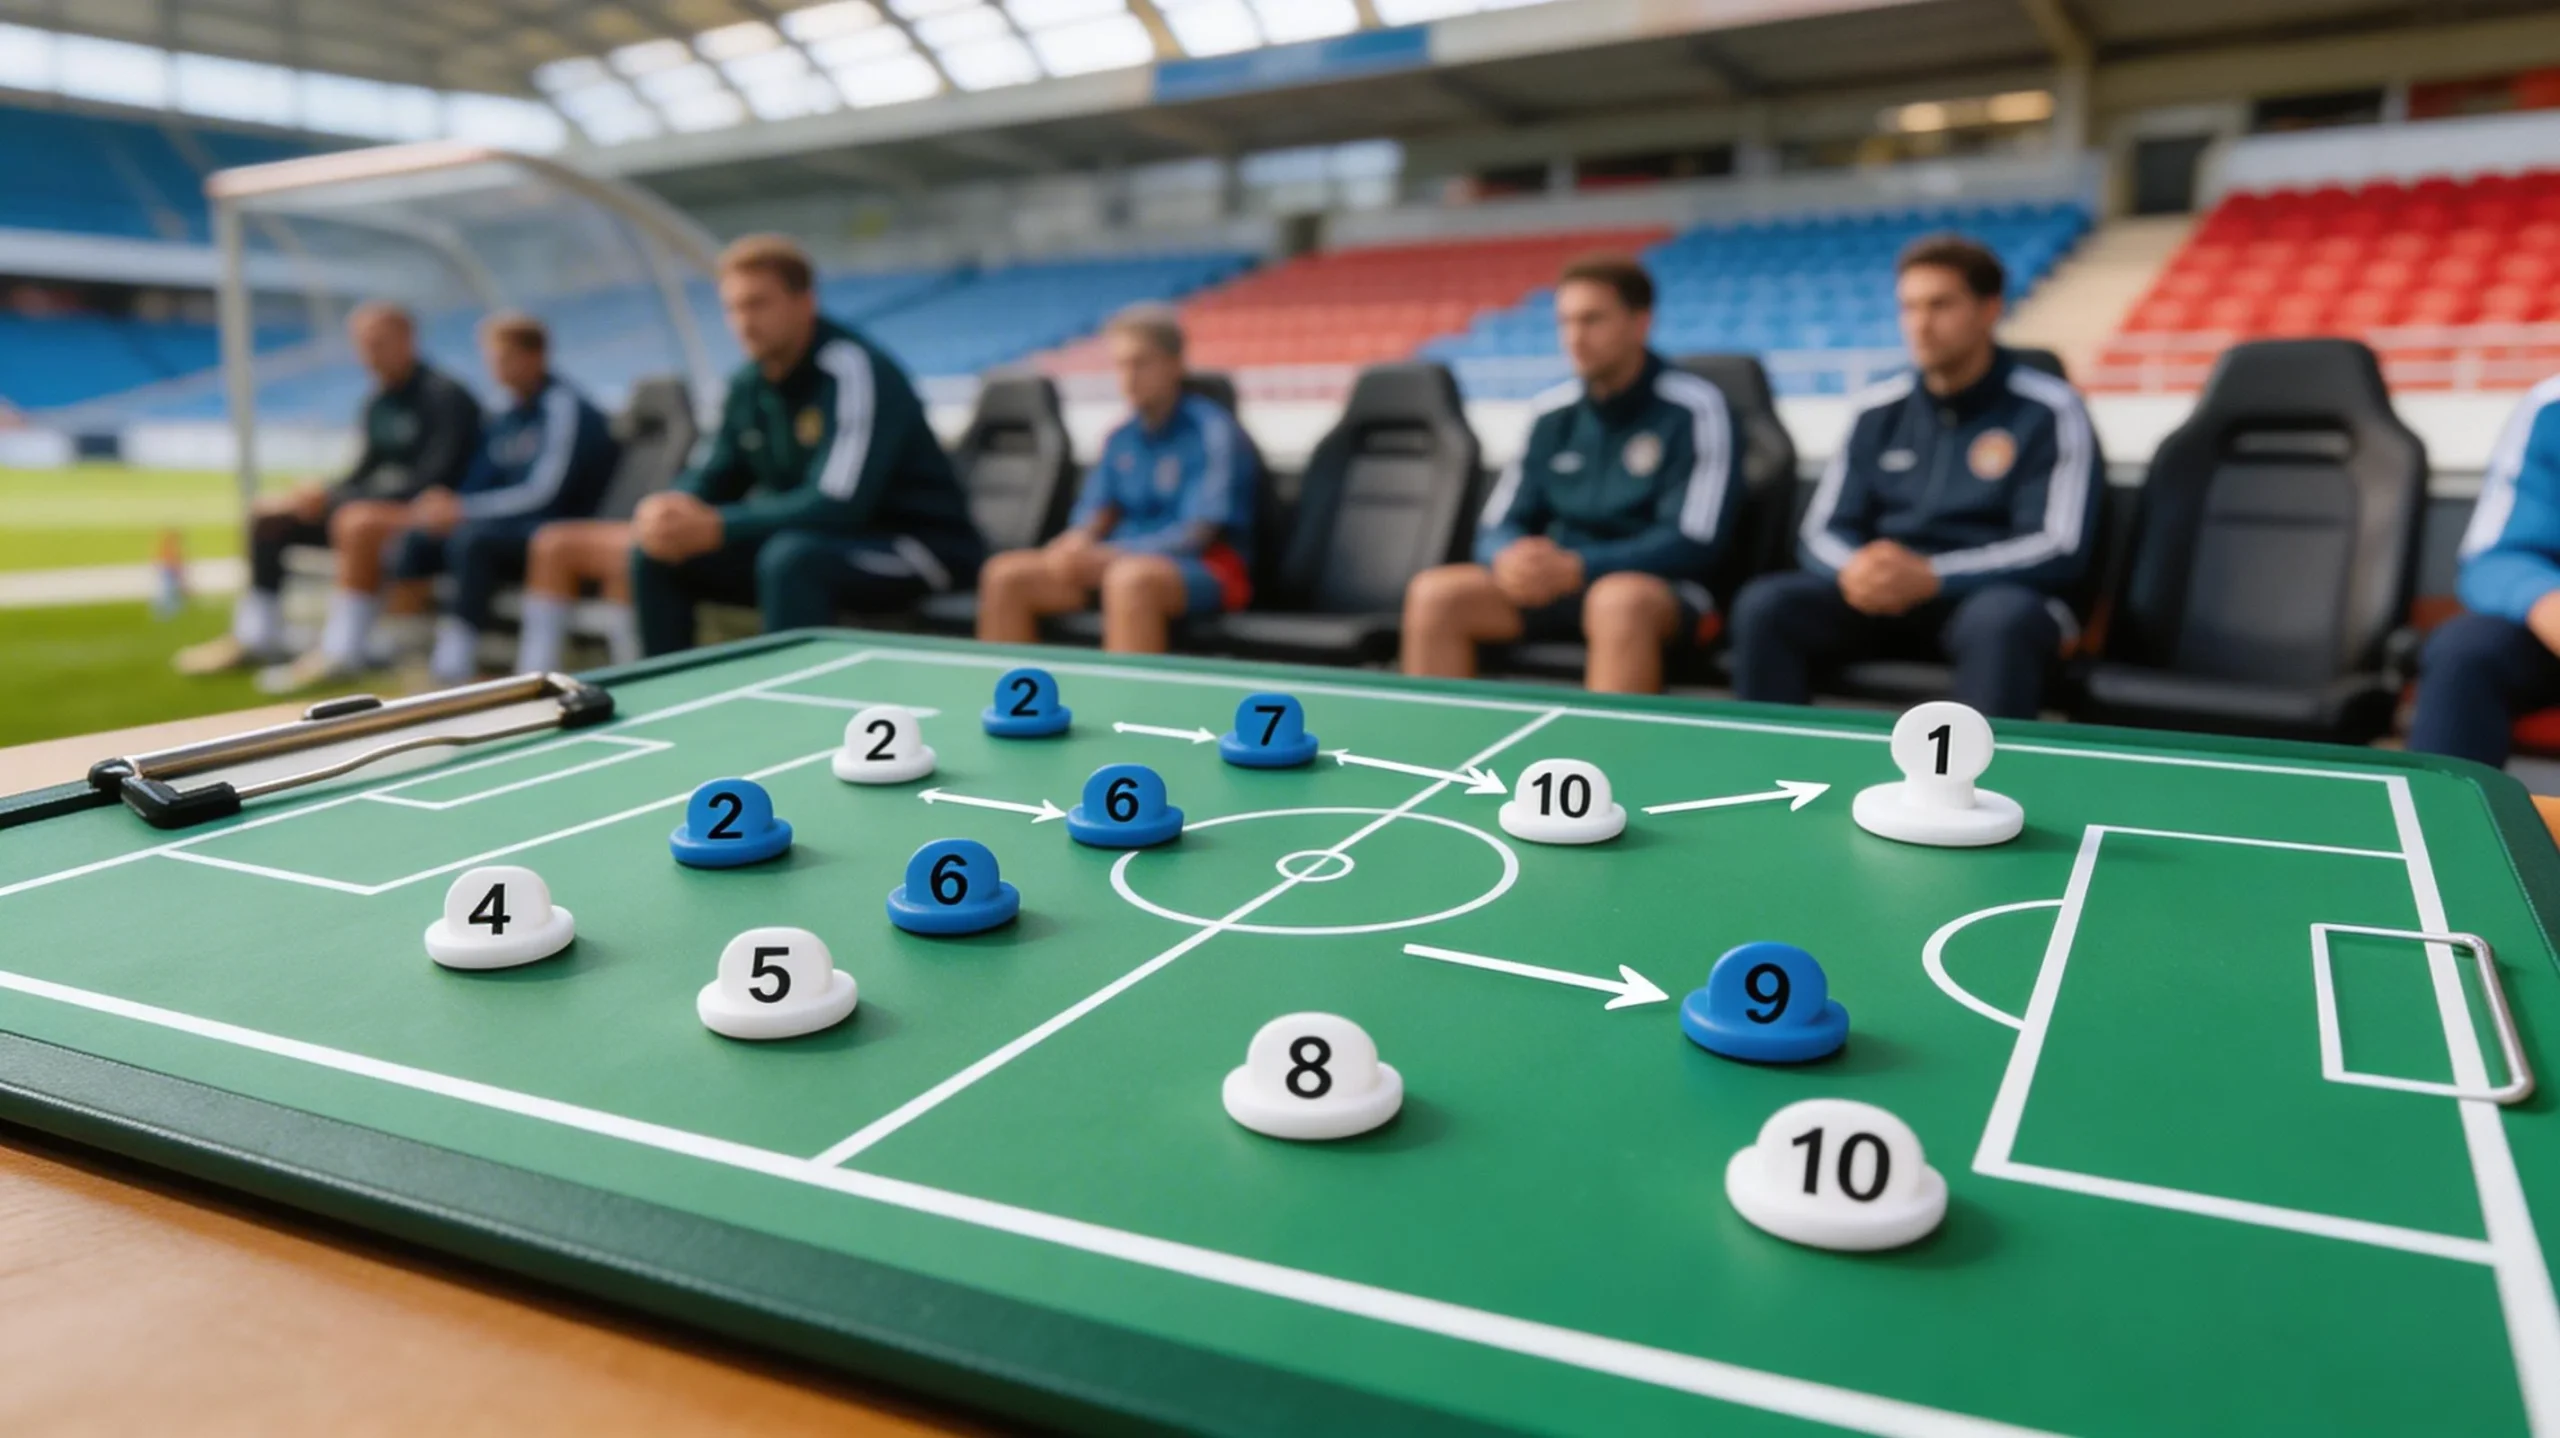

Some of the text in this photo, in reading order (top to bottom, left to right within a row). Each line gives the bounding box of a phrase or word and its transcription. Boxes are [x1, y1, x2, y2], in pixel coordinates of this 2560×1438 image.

[1010, 677, 1040, 718] 2
[865, 718, 897, 762] 2
[1254, 704, 1287, 747] 7
[1927, 723, 1952, 776] 1
[707, 791, 744, 841] 2
[1105, 776, 1140, 824] 6
[1532, 772, 1592, 819] 10
[929, 853, 969, 906] 6
[467, 882, 512, 936] 4
[748, 946, 792, 1004] 5
[1744, 962, 1792, 1025] 9
[1285, 1035, 1333, 1100] 8
[1792, 1127, 1892, 1203] 10
